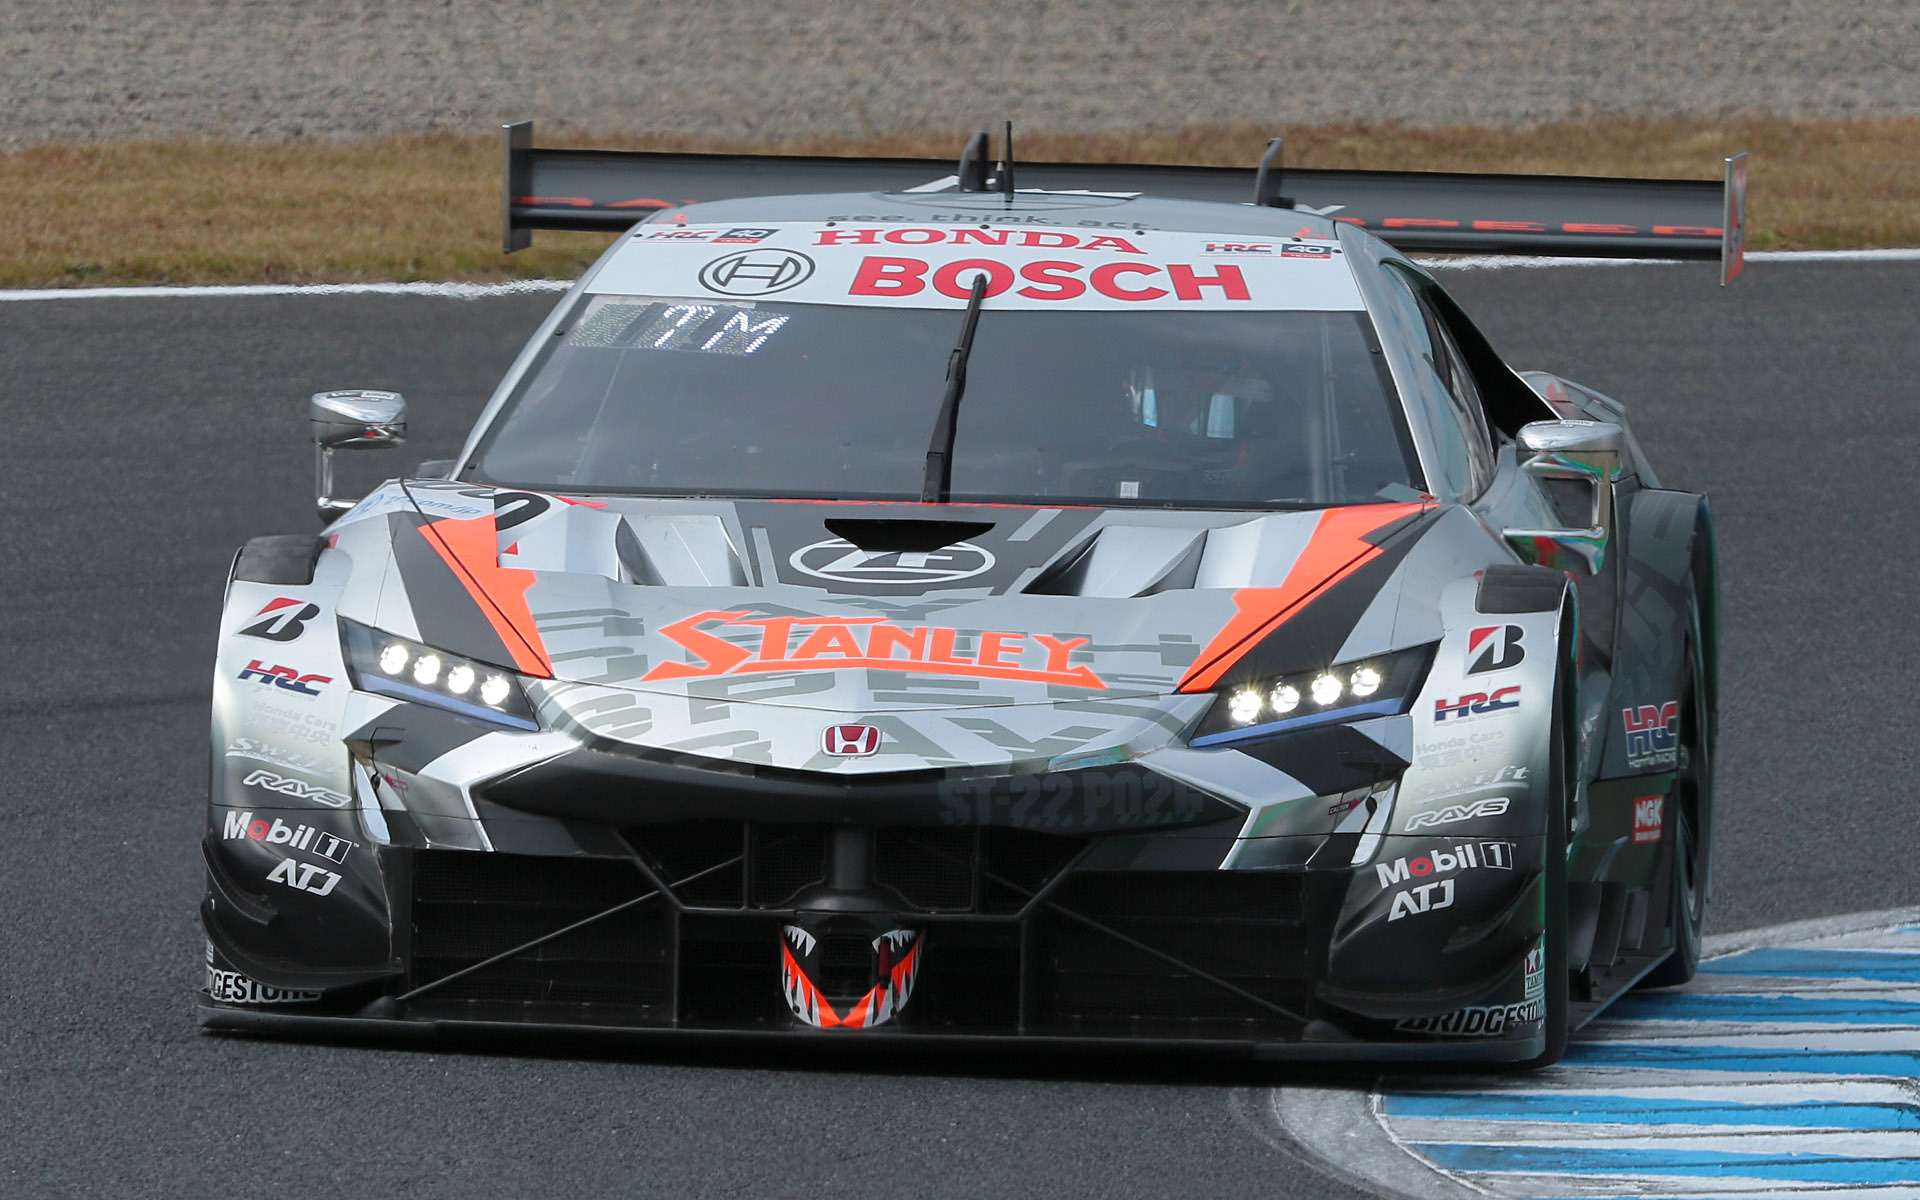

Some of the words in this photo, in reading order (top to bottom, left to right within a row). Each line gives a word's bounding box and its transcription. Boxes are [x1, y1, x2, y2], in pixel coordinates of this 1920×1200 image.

[931, 213, 1062, 225] think.
[811, 228, 1148, 255] HONDA
[1205, 243, 1272, 253] HRC
[1287, 245, 1325, 254] 40
[848, 256, 1252, 302] BOSCH
[641, 610, 1107, 690] STANLEY
[237, 659, 334, 696] HRC
[253, 700, 303, 721] Honda
[304, 713, 337, 731] Cars
[1434, 685, 1521, 721] HRC
[1415, 736, 1467, 755] Honda
[1469, 730, 1505, 744] Cars
[1622, 700, 1678, 757] HRC
[243, 769, 352, 808] RAYS
[223, 811, 315, 850] Mobil
[1404, 797, 1510, 832] RAYS
[1634, 799, 1663, 829] NGK
[266, 858, 342, 896] ATJ
[1375, 843, 1477, 889] Mobil
[1388, 878, 1455, 922] ATJ
